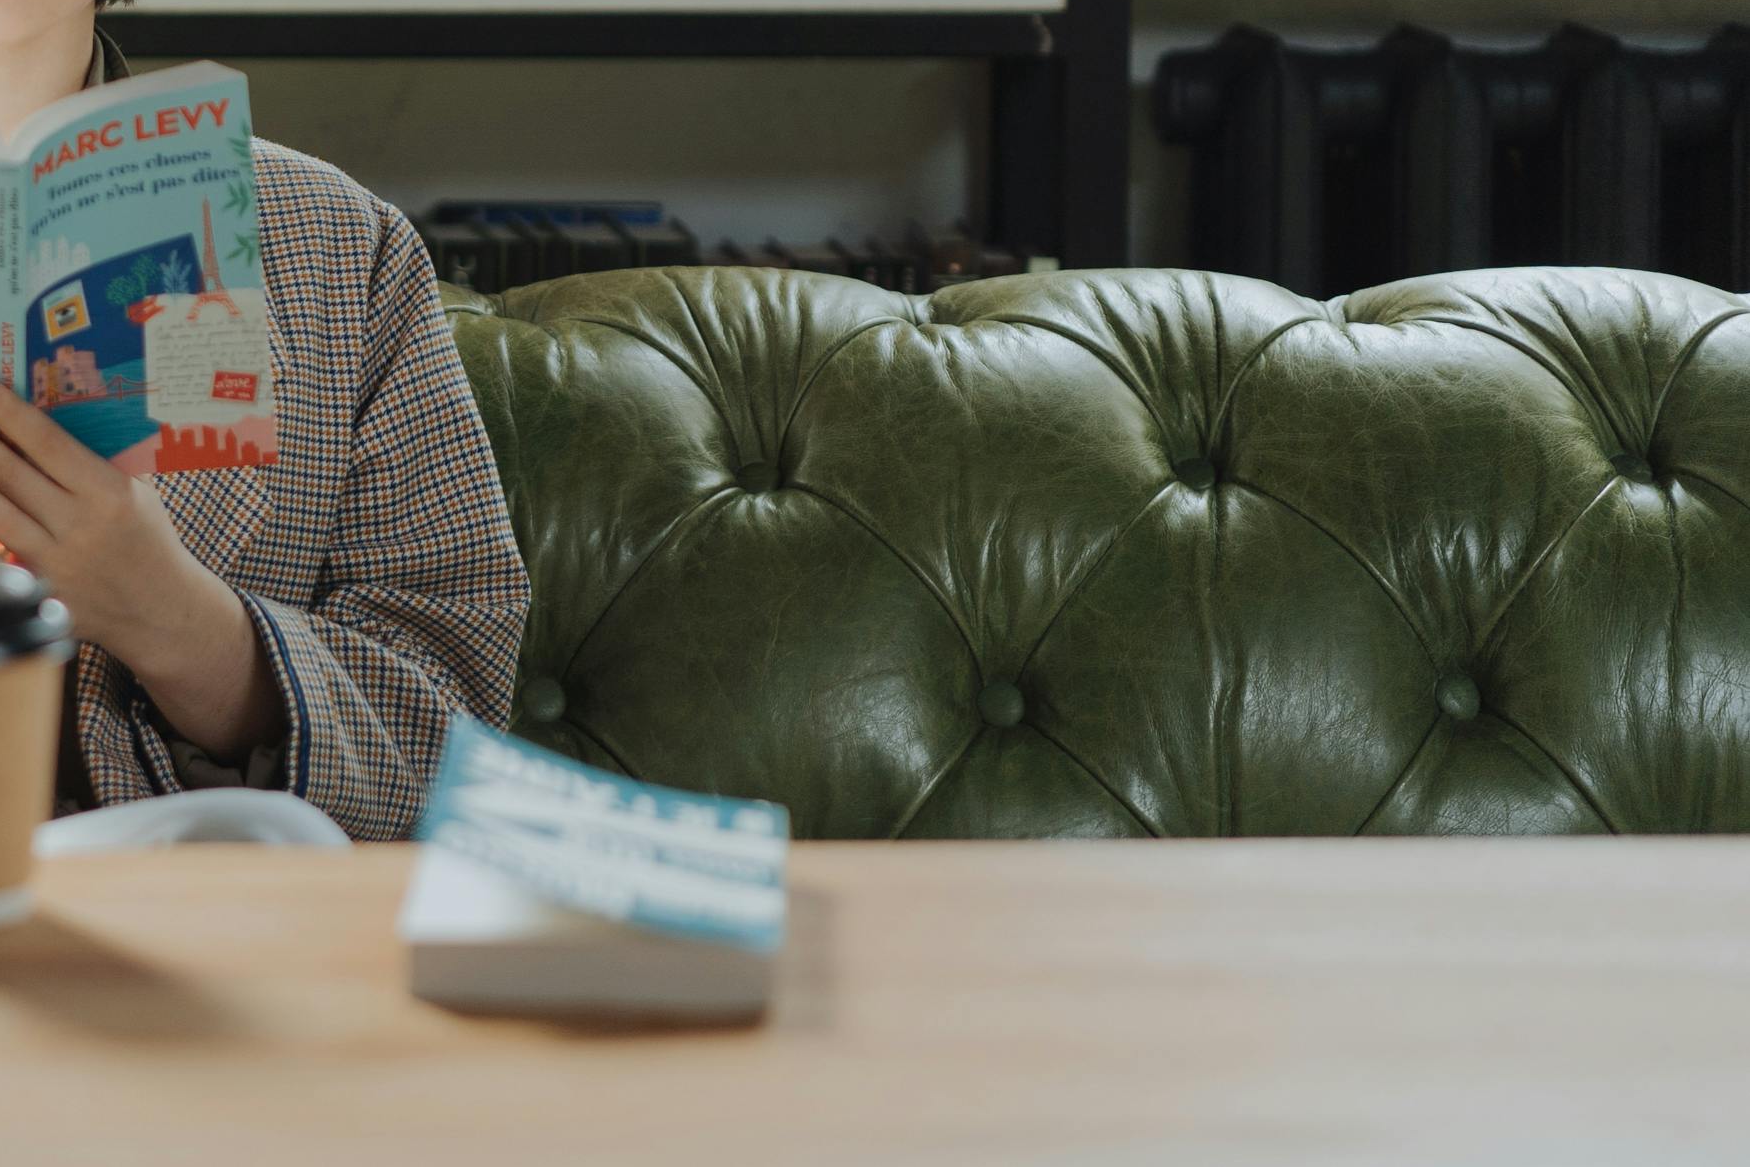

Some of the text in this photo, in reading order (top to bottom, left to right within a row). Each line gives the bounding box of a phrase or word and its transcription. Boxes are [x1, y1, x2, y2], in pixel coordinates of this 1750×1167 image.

[32, 98, 230, 185] MARC LEVY
[31, 166, 240, 234] qu'on ne s'est pas dites
[47, 149, 211, 201] Toutes ces choses
[2, 322, 15, 355] LEVY
